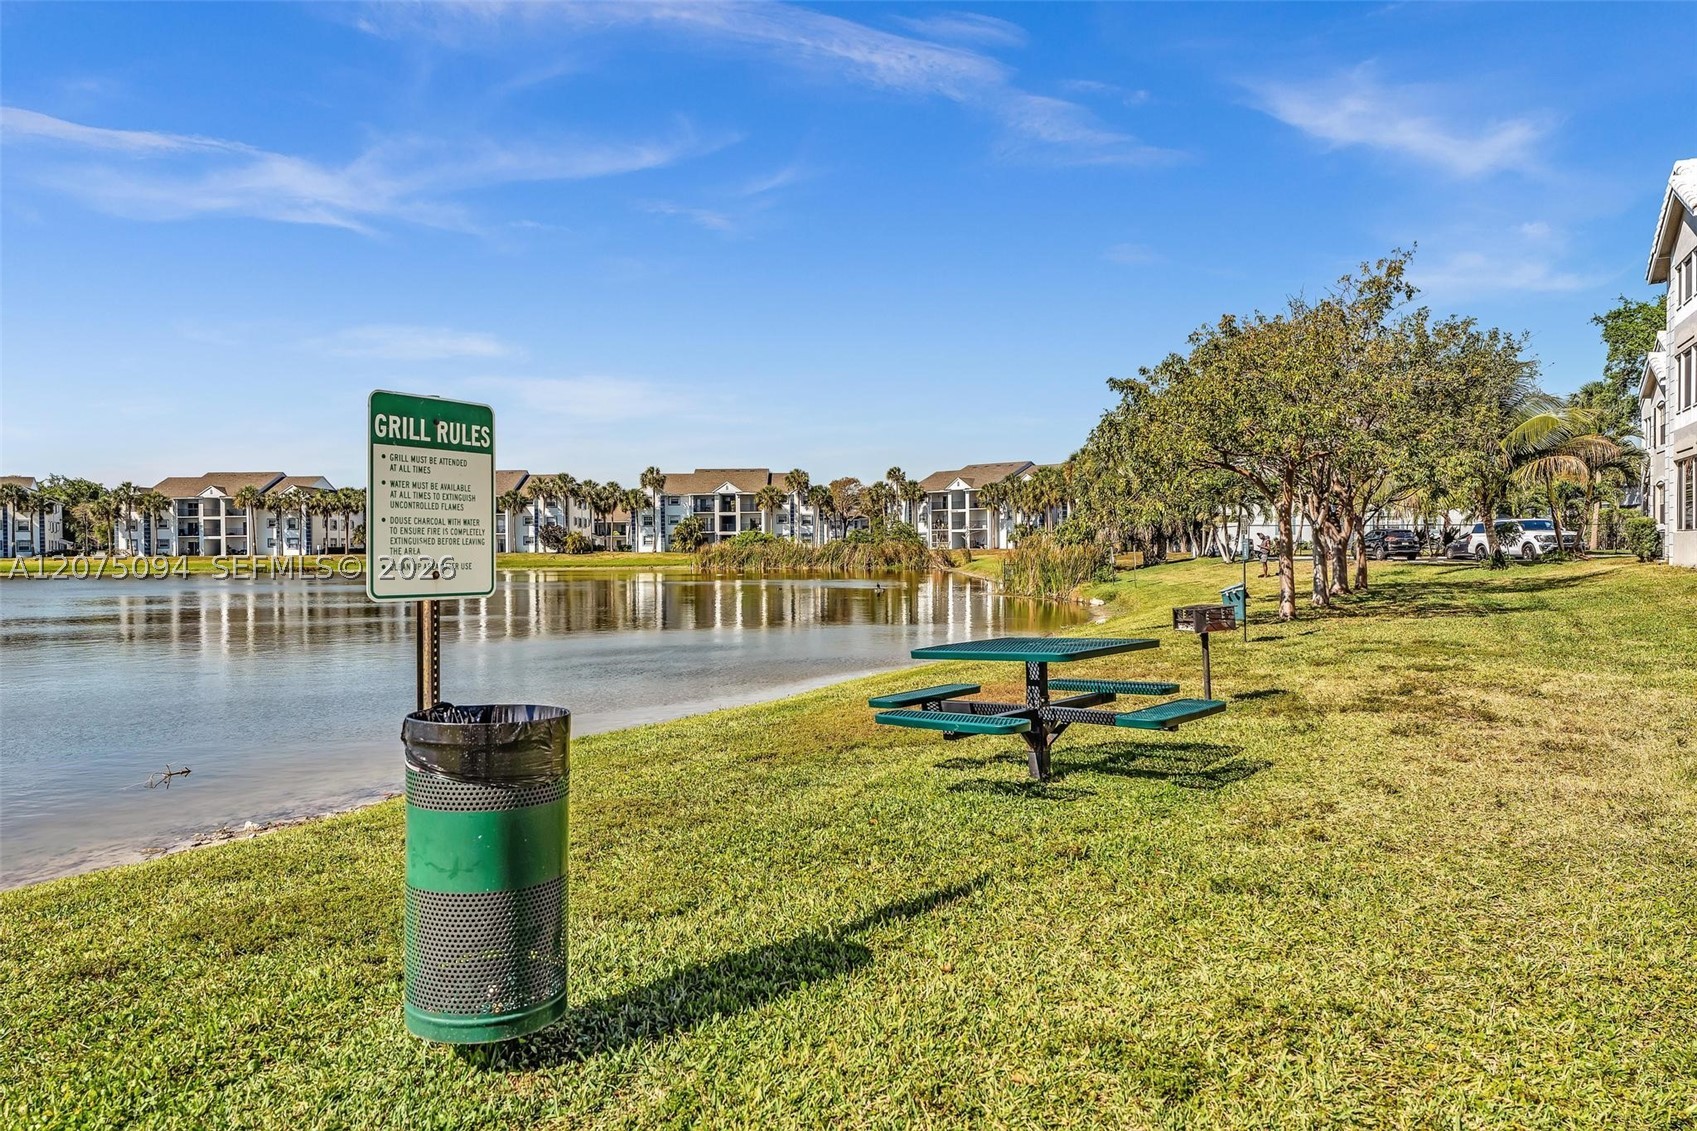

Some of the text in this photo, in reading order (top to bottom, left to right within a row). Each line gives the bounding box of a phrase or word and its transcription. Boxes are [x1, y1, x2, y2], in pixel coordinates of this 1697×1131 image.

[374, 414, 490, 448] GRILL RULES
[390, 453, 409, 463] GRILL
[411, 455, 427, 464] MUST
[439, 458, 467, 467] ATTENDED
[390, 464, 431, 474] AT ALL TIMES
[390, 480, 410, 488] WATER
[412, 481, 428, 490] MUST
[440, 483, 471, 492] AVAILABLE
[399, 491, 411, 499] ALL
[413, 492, 431, 500] TIMES
[442, 493, 476, 502] EXTINGUISH
[390, 501, 464, 511] UNCONTROLLED FLAMES
[390, 516, 412, 524] DOUSE
[414, 517, 446, 525] CHARCOAL
